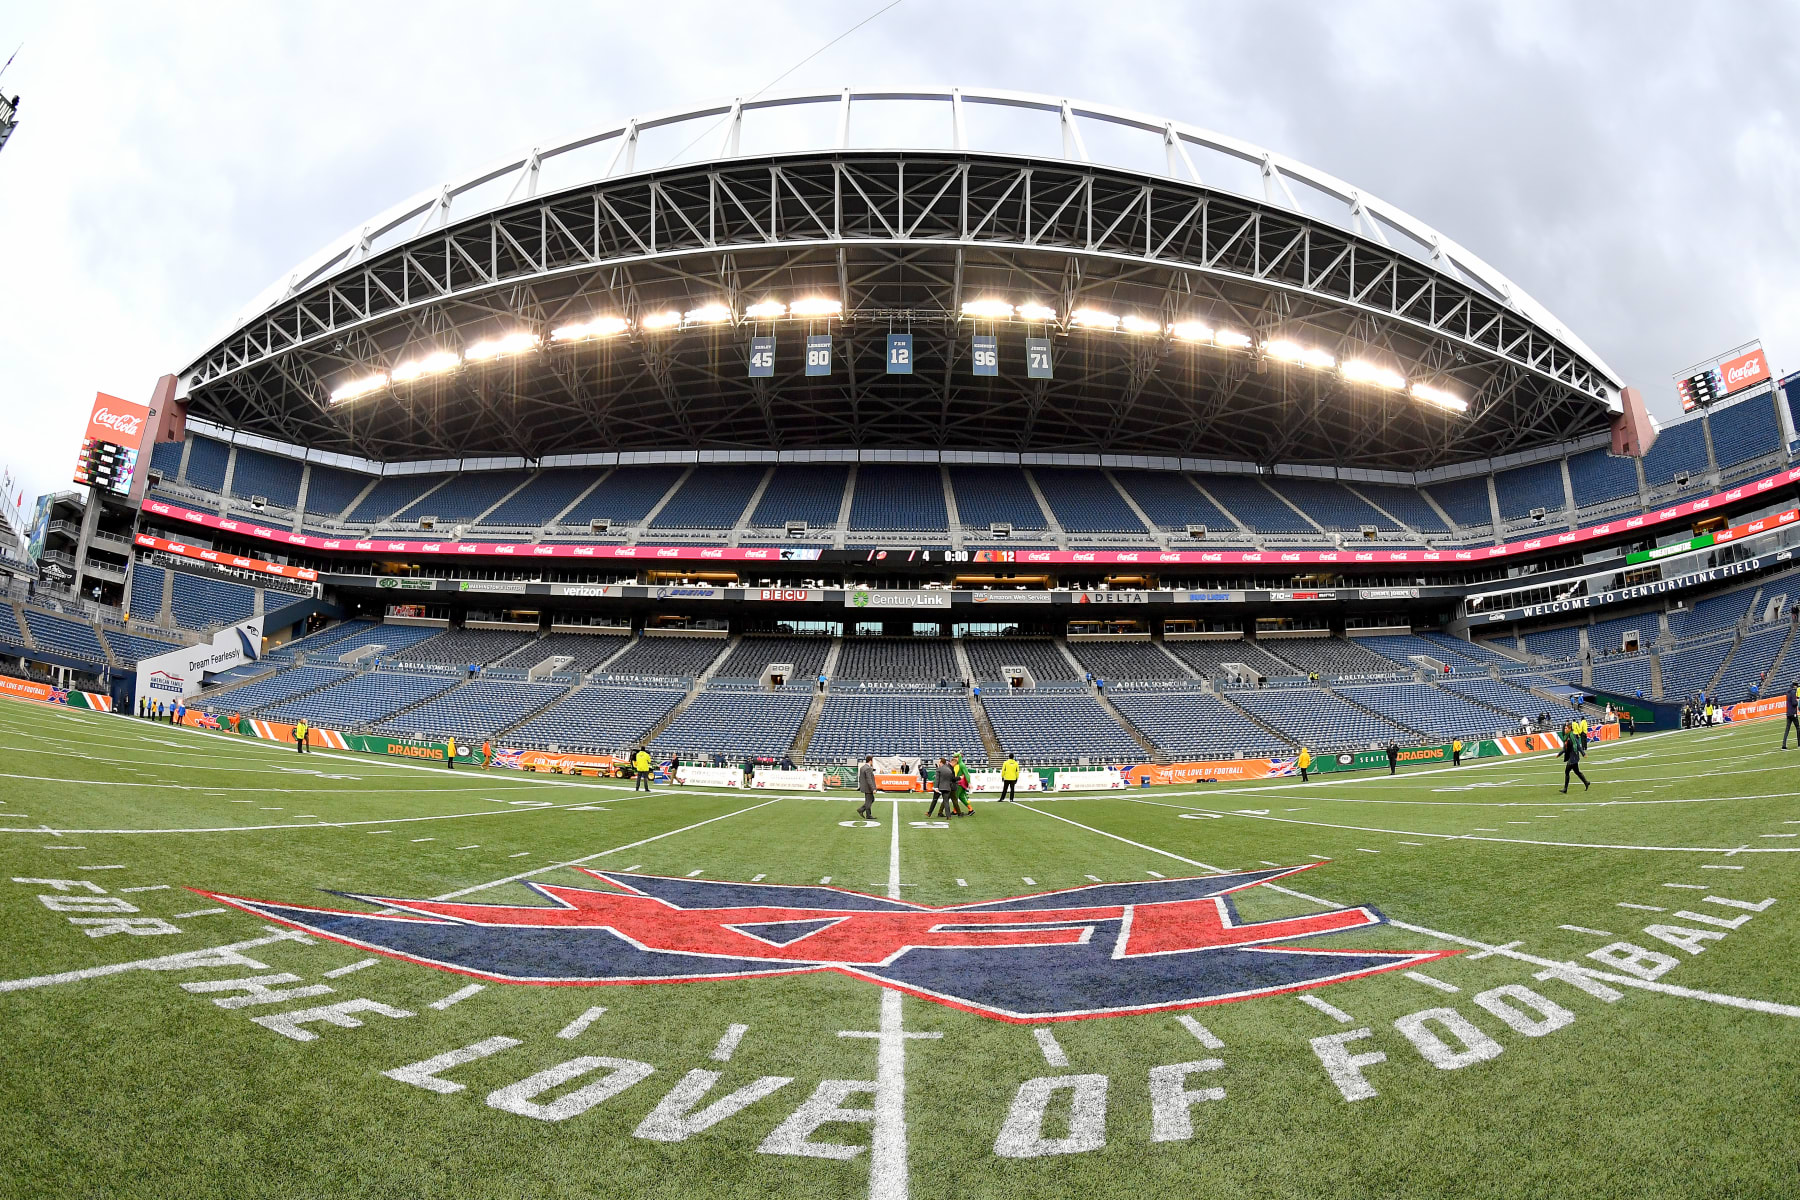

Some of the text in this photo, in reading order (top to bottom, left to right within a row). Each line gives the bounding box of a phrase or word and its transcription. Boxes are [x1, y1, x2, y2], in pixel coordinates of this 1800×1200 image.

[752, 352, 773, 367] 45
[808, 351, 829, 366] 80
[891, 349, 909, 364] 12
[974, 351, 996, 366] 96
[1030, 353, 1049, 369] 71
[1728, 357, 1760, 384] Coca-Cola
[93, 407, 143, 436] Coca-Cola
[922, 550, 969, 562] 4 0:00
[1002, 550, 1015, 562] 12
[563, 586, 604, 597] verizon
[670, 589, 714, 597] BOEING
[1523, 559, 1760, 617] WELCOME TO CENTURYLINK FIELD
[762, 590, 806, 601] BECU
[872, 594, 943, 607] CenturyLink
[1095, 593, 1142, 603] DELTA
[1271, 592, 1285, 600] 710
[1292, 592, 1319, 600] ESPN
[189, 648, 240, 672] Dream Fearlessly
[6, 682, 18, 690] LOVE
[24, 685, 46, 696] FOOTBALL
[1756, 704, 1768, 712] LOVE
[399, 739, 432, 748] SEATTLE
[387, 743, 443, 760] DRAGONS
[1396, 748, 1444, 761] DRAGONS
[1360, 755, 1390, 763] SEATTL
[1160, 769, 1173, 777] FOR
[1174, 769, 1186, 777] THE
[1187, 768, 1204, 776] LOVE
[1213, 766, 1244, 775] FOOTBALL
[187, 855, 1466, 1020] XFL
[10, 877, 1778, 1160] FOR THE LOVE OF FOOTBALL
